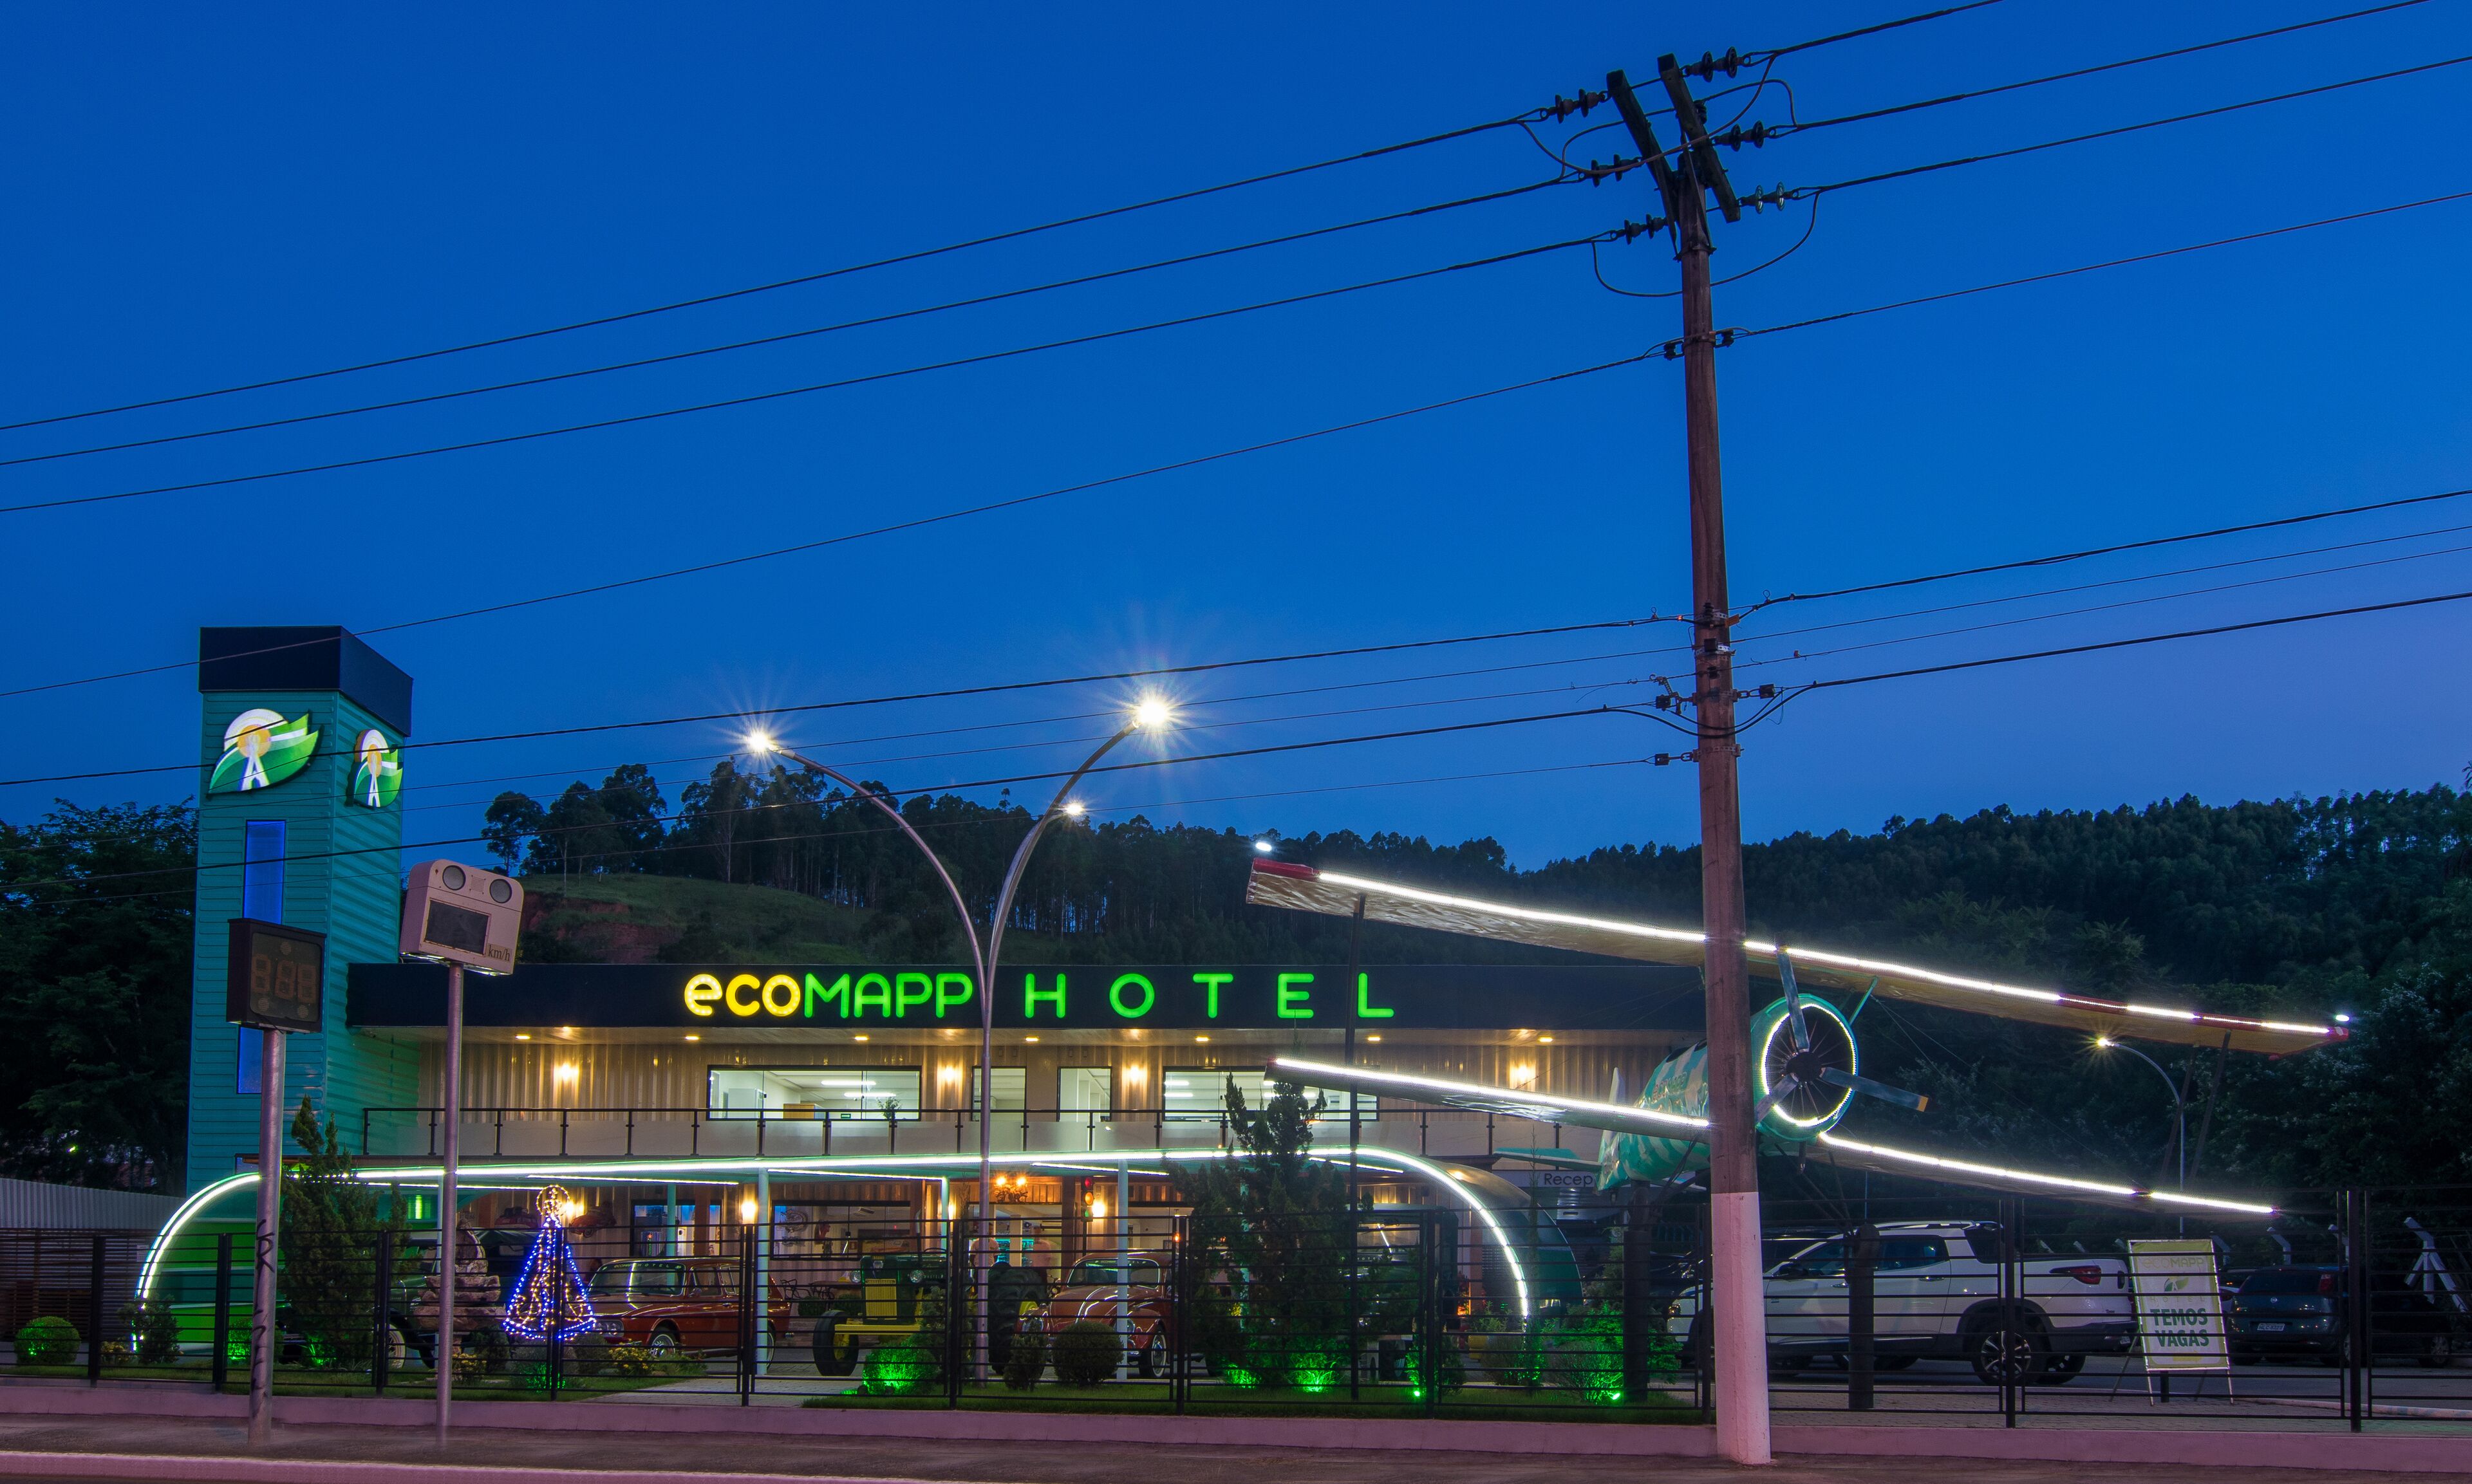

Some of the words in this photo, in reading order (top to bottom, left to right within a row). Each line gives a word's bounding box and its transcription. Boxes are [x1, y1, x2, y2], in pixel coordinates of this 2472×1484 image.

[488, 944, 510, 961] km/h
[684, 972, 973, 1018] ecoMAPP
[1025, 972, 1394, 1018] HOTEL
[1544, 1173, 1593, 1187] Recep
[2151, 1308, 2207, 1326] TEMOS
[2155, 1330, 2209, 1347] VAGAS
